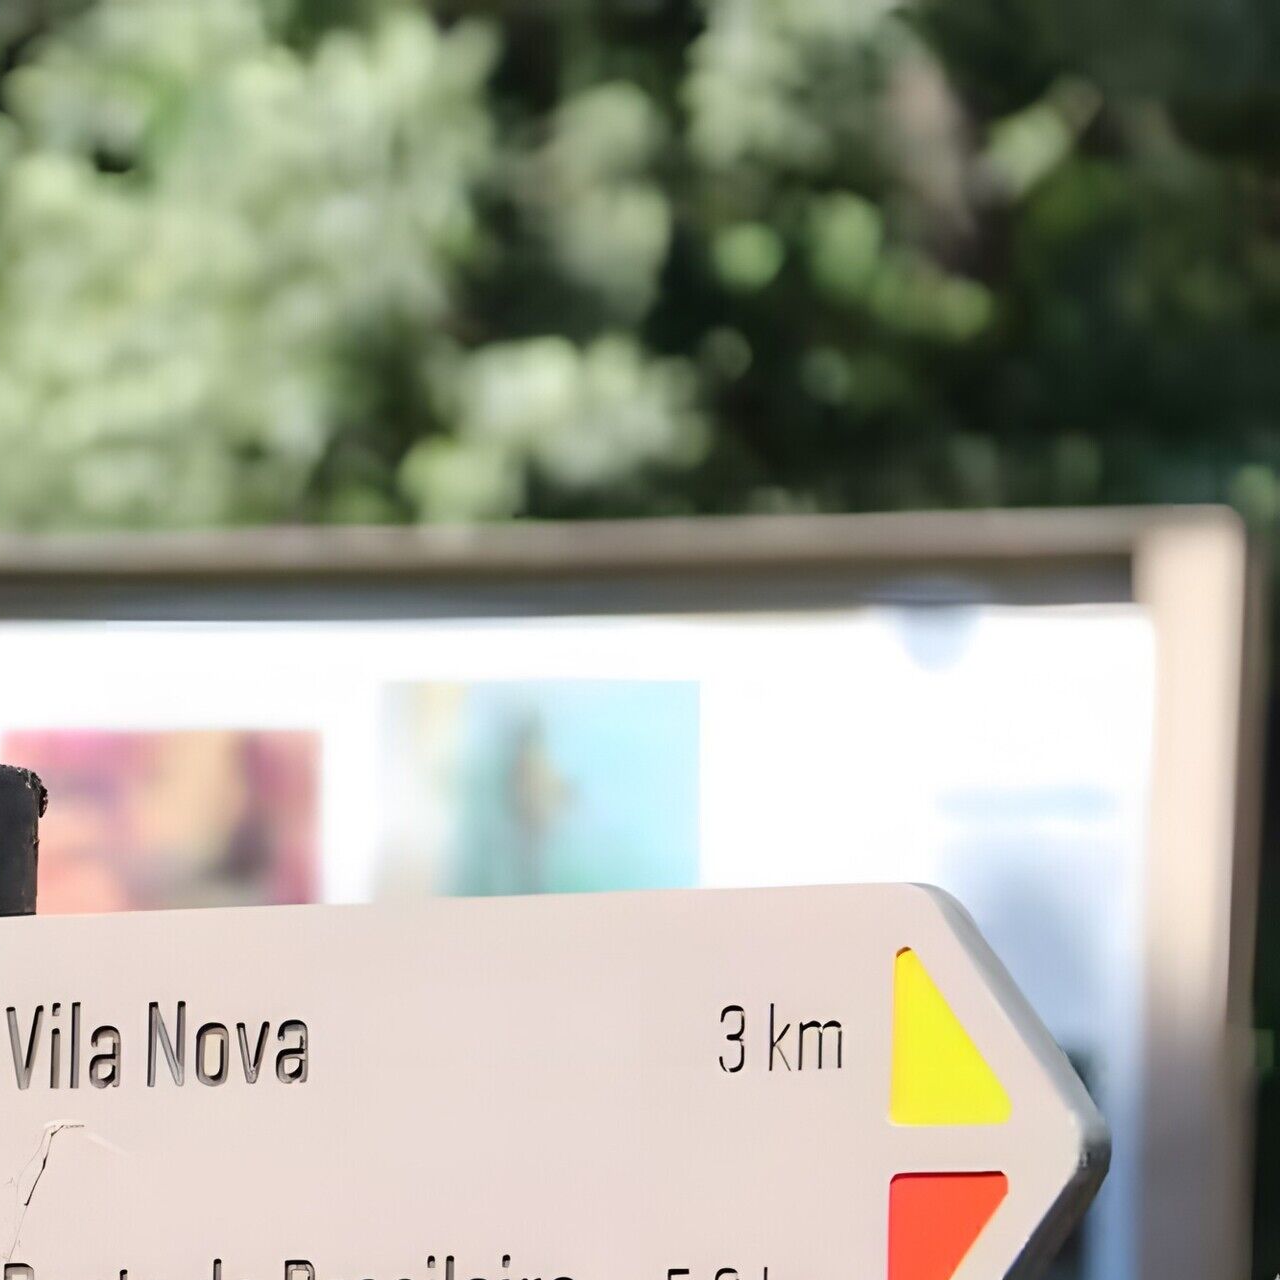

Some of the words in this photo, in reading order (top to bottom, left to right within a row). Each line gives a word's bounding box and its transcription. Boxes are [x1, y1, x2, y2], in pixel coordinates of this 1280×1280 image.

[5, 1001, 122, 1091] Vila
[145, 1000, 309, 1088] Nova
[717, 1003, 747, 1074] 3
[767, 1002, 844, 1073] km
